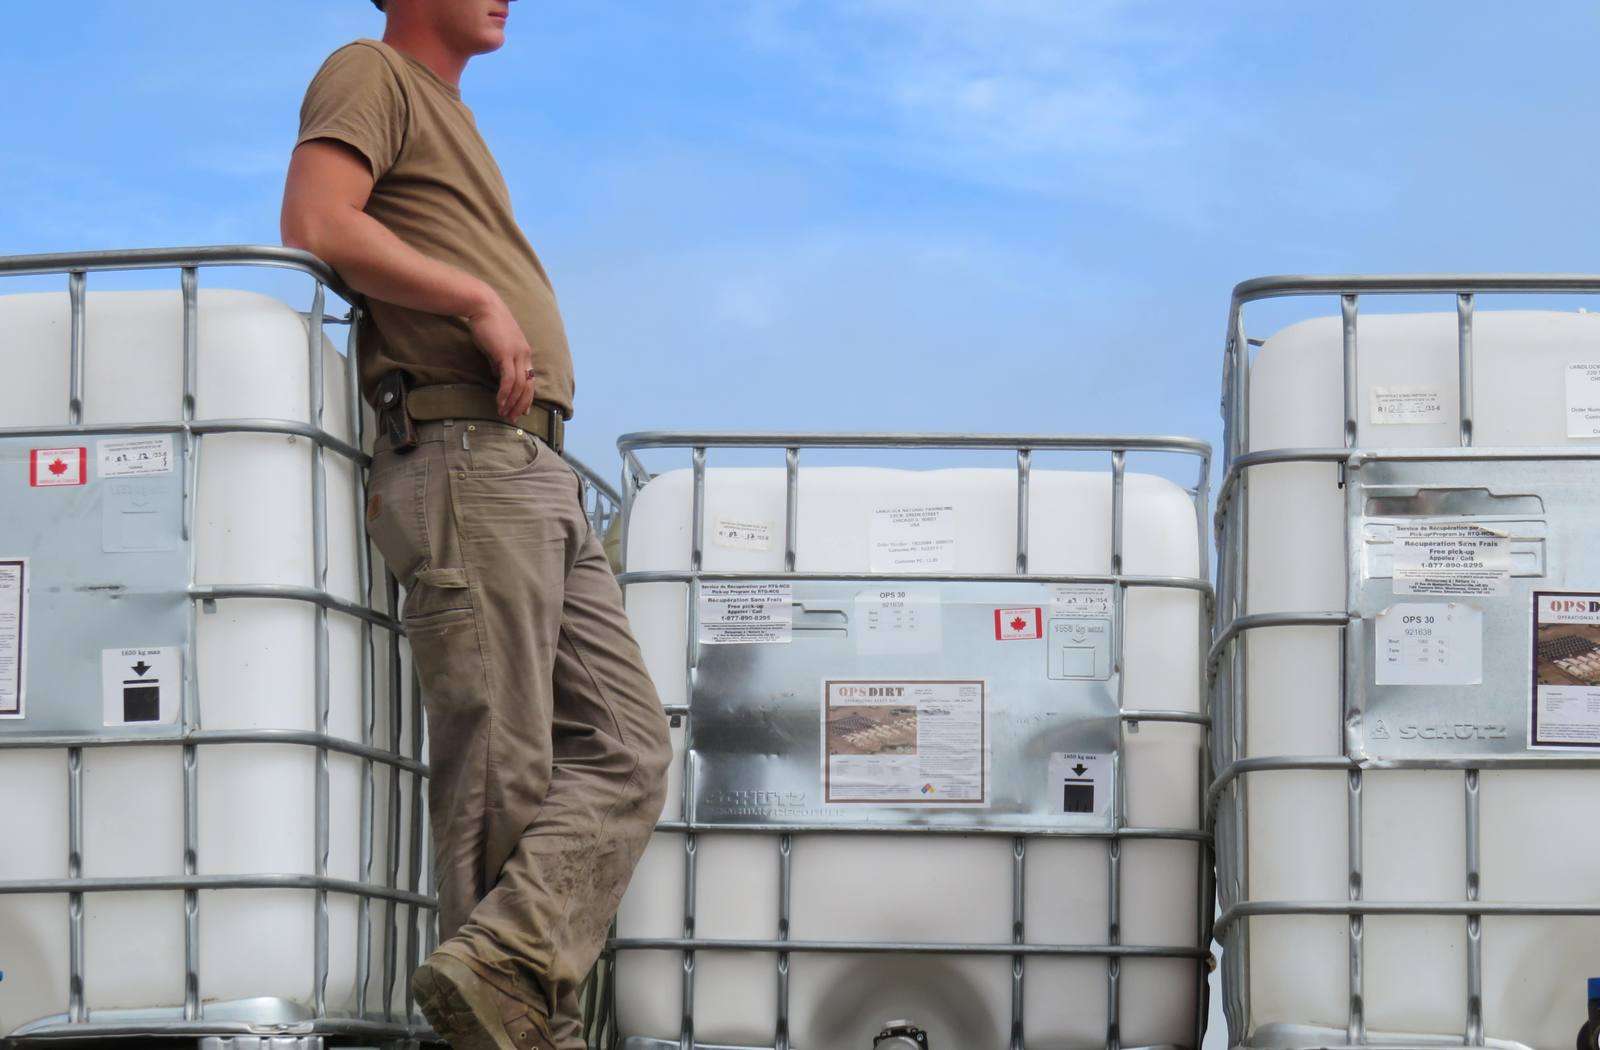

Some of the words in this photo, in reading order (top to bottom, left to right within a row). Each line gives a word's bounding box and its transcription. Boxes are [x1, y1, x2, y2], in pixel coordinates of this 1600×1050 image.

[1404, 540, 1455, 548] Récupération
[1402, 616, 1422, 624] OPS
[1424, 616, 1435, 624] 30
